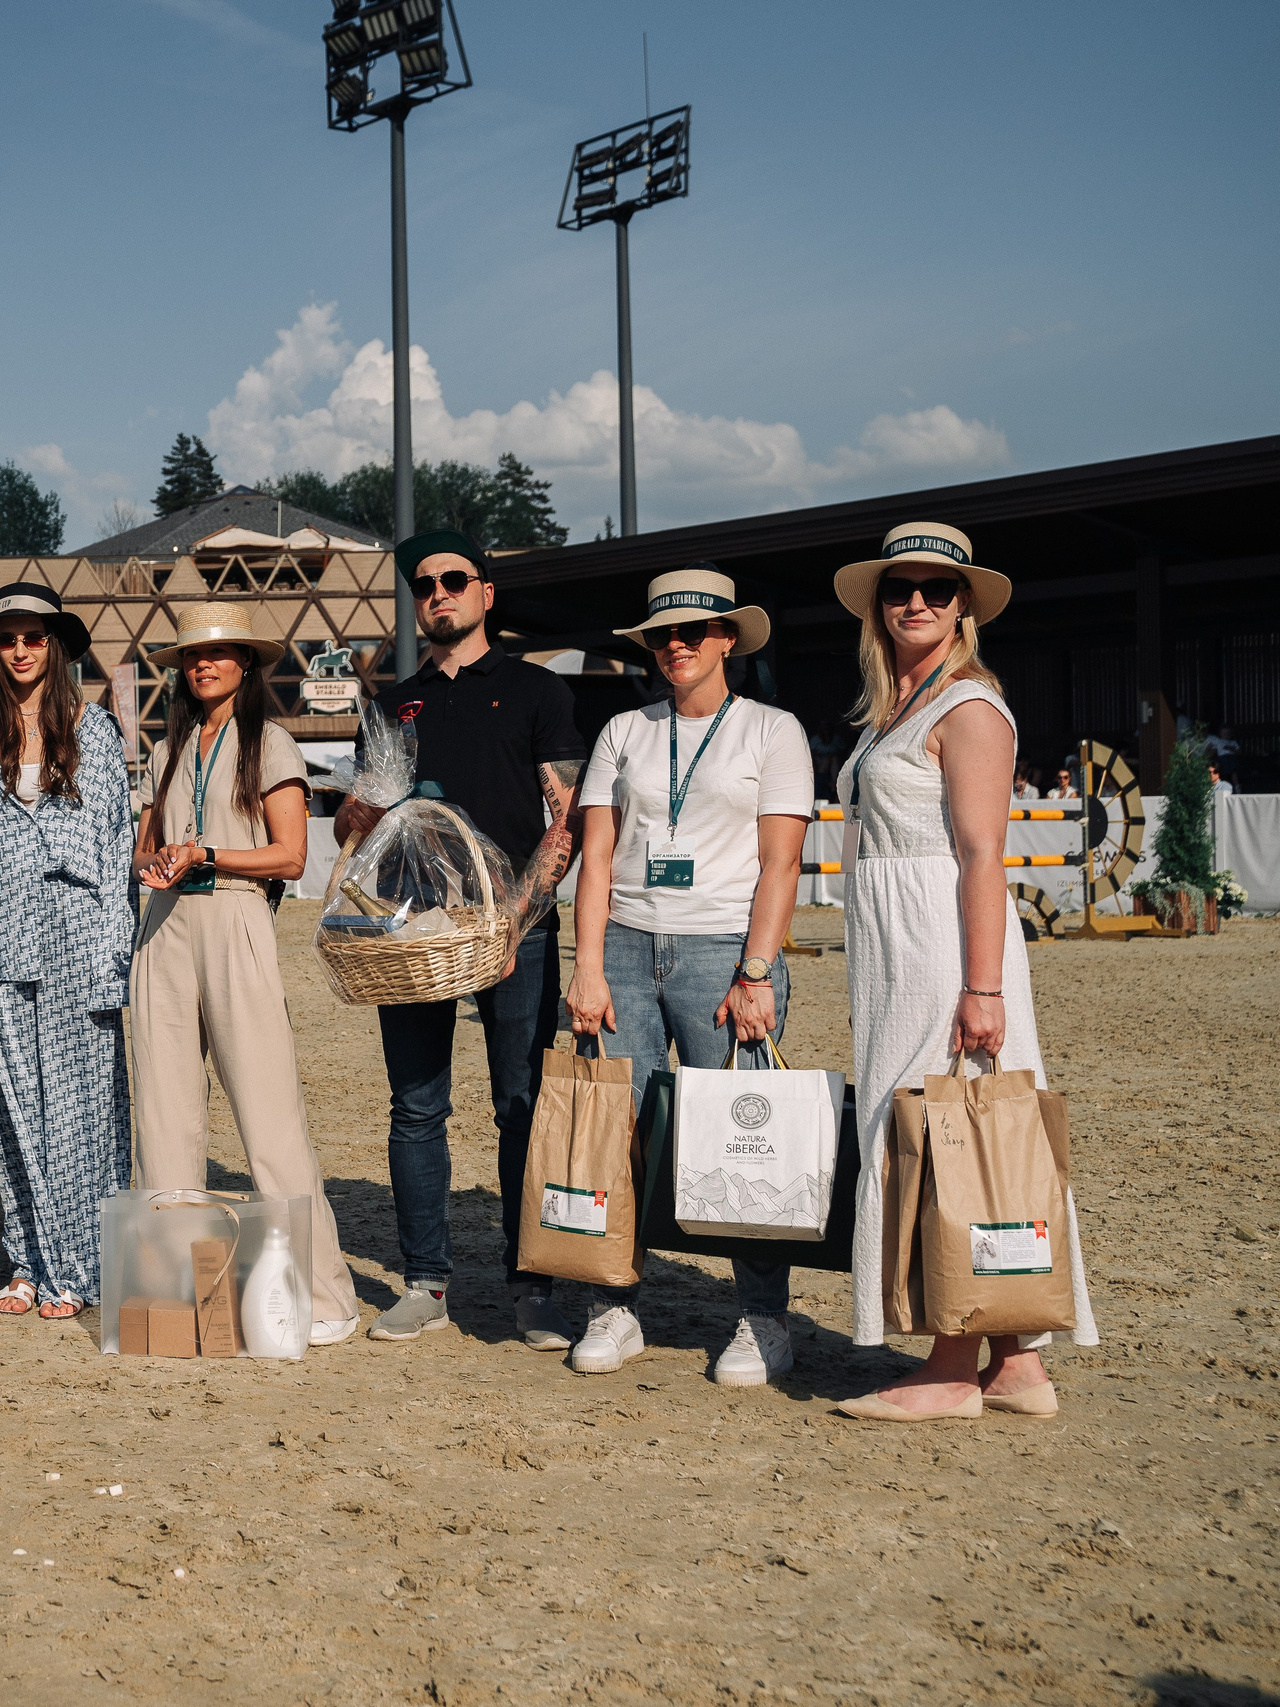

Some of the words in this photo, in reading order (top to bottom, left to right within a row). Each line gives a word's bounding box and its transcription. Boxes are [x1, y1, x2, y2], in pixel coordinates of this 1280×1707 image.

[889, 538, 920, 555] EMERALD
[922, 538, 953, 555] STABLES
[953, 547, 964, 561] CUP
[671, 594, 700, 605] STABLES
[702, 596, 714, 607] CUP
[706, 719, 720, 739] EMERALD
[719, 701, 731, 719] STABLES
[546, 785, 555, 798] TO
[552, 798, 561, 808] BE
[678, 775, 689, 801] EMERALD
[725, 1143, 775, 1154] SIBERICA
[734, 1135, 767, 1143] NATURA
